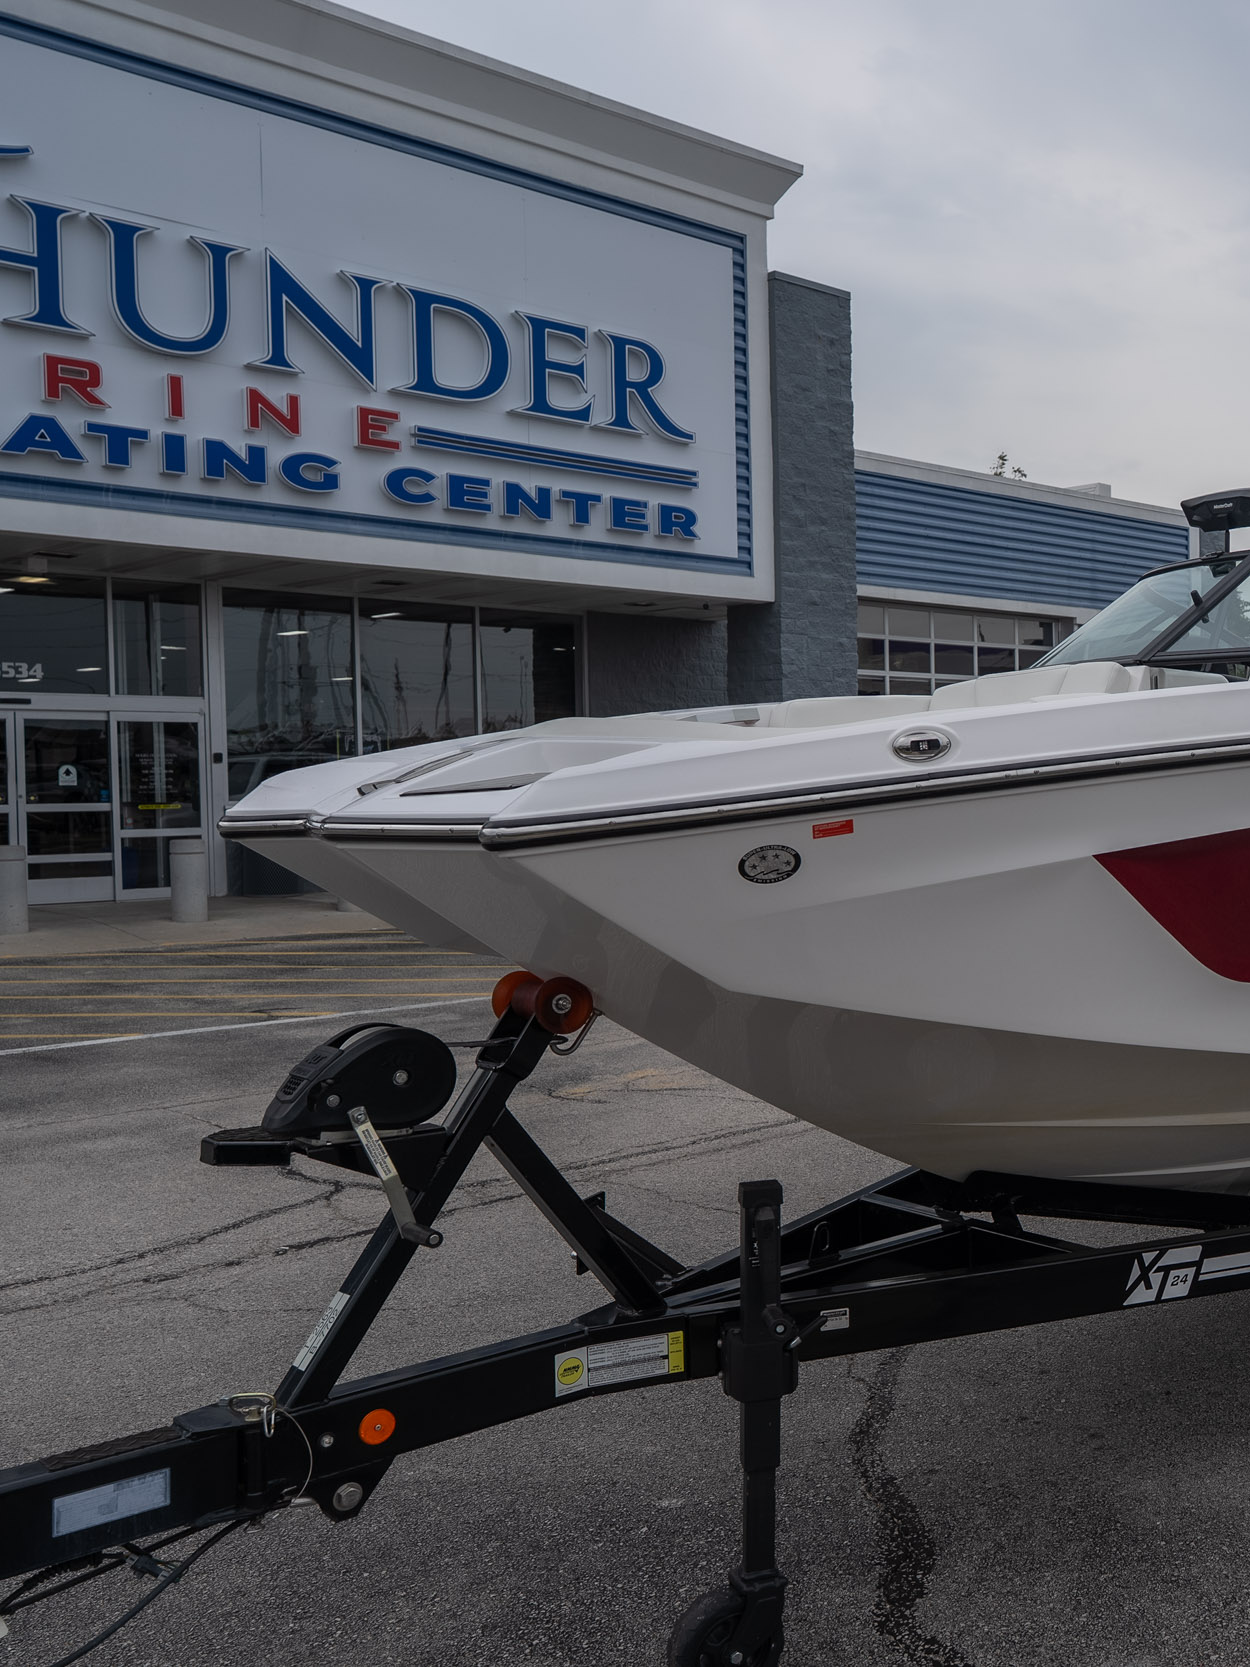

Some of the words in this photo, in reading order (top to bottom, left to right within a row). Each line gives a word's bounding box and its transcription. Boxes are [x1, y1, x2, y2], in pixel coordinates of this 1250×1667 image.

[0, 145, 697, 445] HUNDER
[0, 412, 342, 494] ATING
[383, 466, 700, 541] CENTER
[0, 662, 44, 679] 534
[1170, 1273, 1189, 1287] 24
